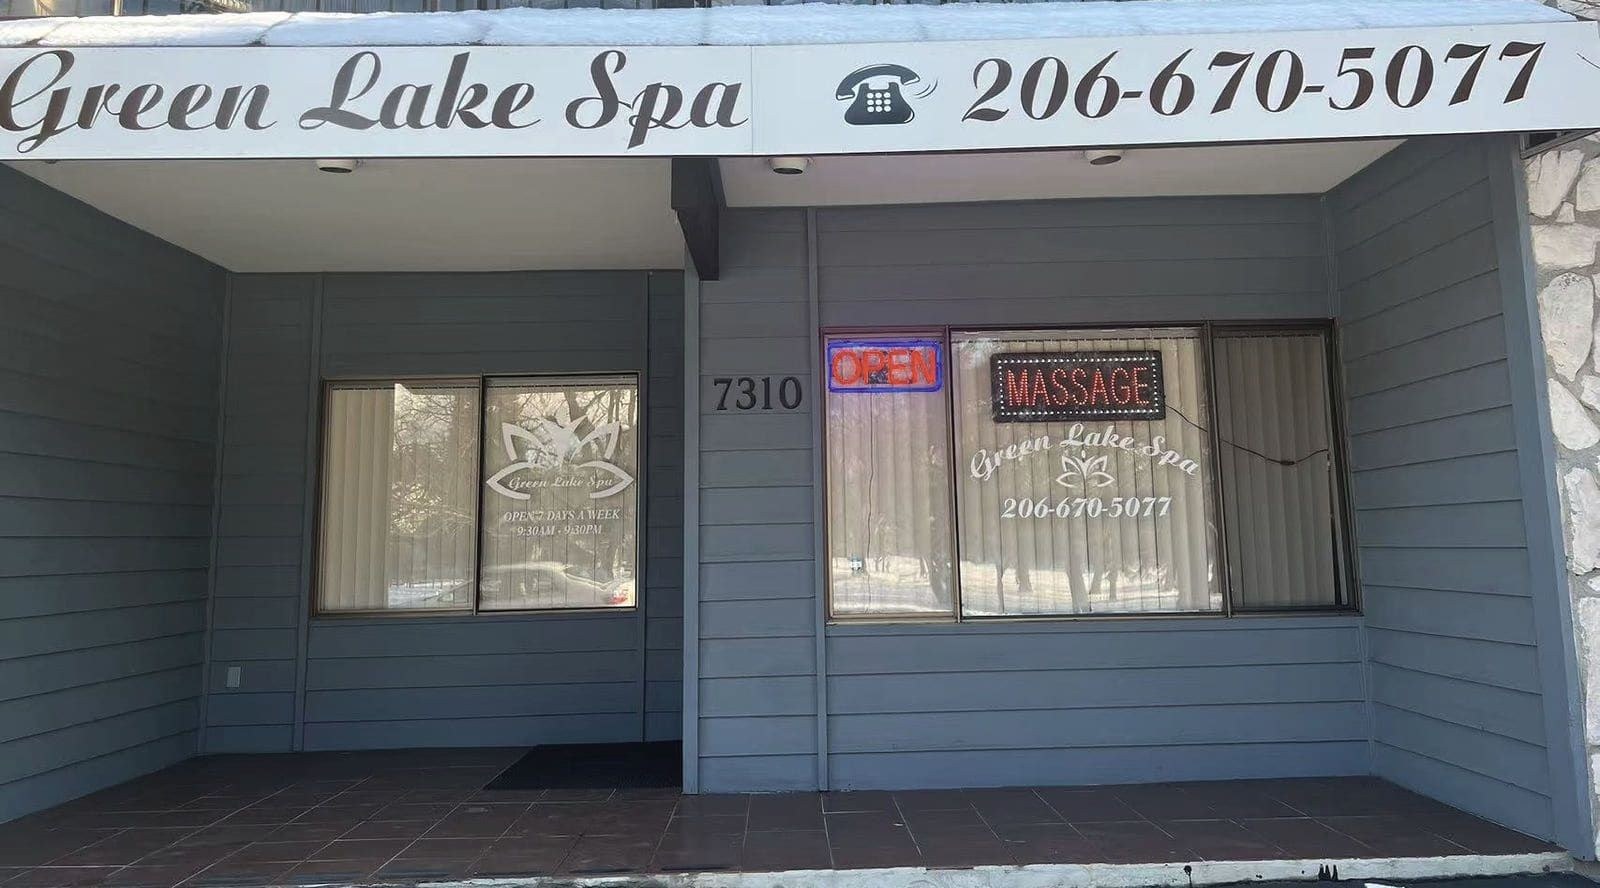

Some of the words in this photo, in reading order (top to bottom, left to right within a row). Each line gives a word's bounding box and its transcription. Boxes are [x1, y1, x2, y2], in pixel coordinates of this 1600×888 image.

[962, 41, 1547, 122] 206-670-5077
[1, 50, 277, 153] Green
[299, 51, 542, 131] Lake
[565, 50, 748, 149] Spa
[832, 349, 936, 385] OPEN
[713, 376, 803, 411] 7310
[1007, 367, 1150, 406] MASSAGE
[970, 434, 1052, 481] Green
[1059, 423, 1136, 451] Lake
[1141, 435, 1200, 476] Spa
[509, 477, 547, 491] Green
[551, 476, 584, 488] Lake
[587, 475, 613, 489] Spa
[504, 511, 536, 521] OPEN
[547, 510, 575, 521] DAYS
[577, 511, 585, 520] A
[588, 508, 621, 520] WEEK
[1001, 496, 1172, 519] 206-670-5077
[517, 526, 555, 536] 9:30AM
[564, 525, 602, 535] 9:30PM
